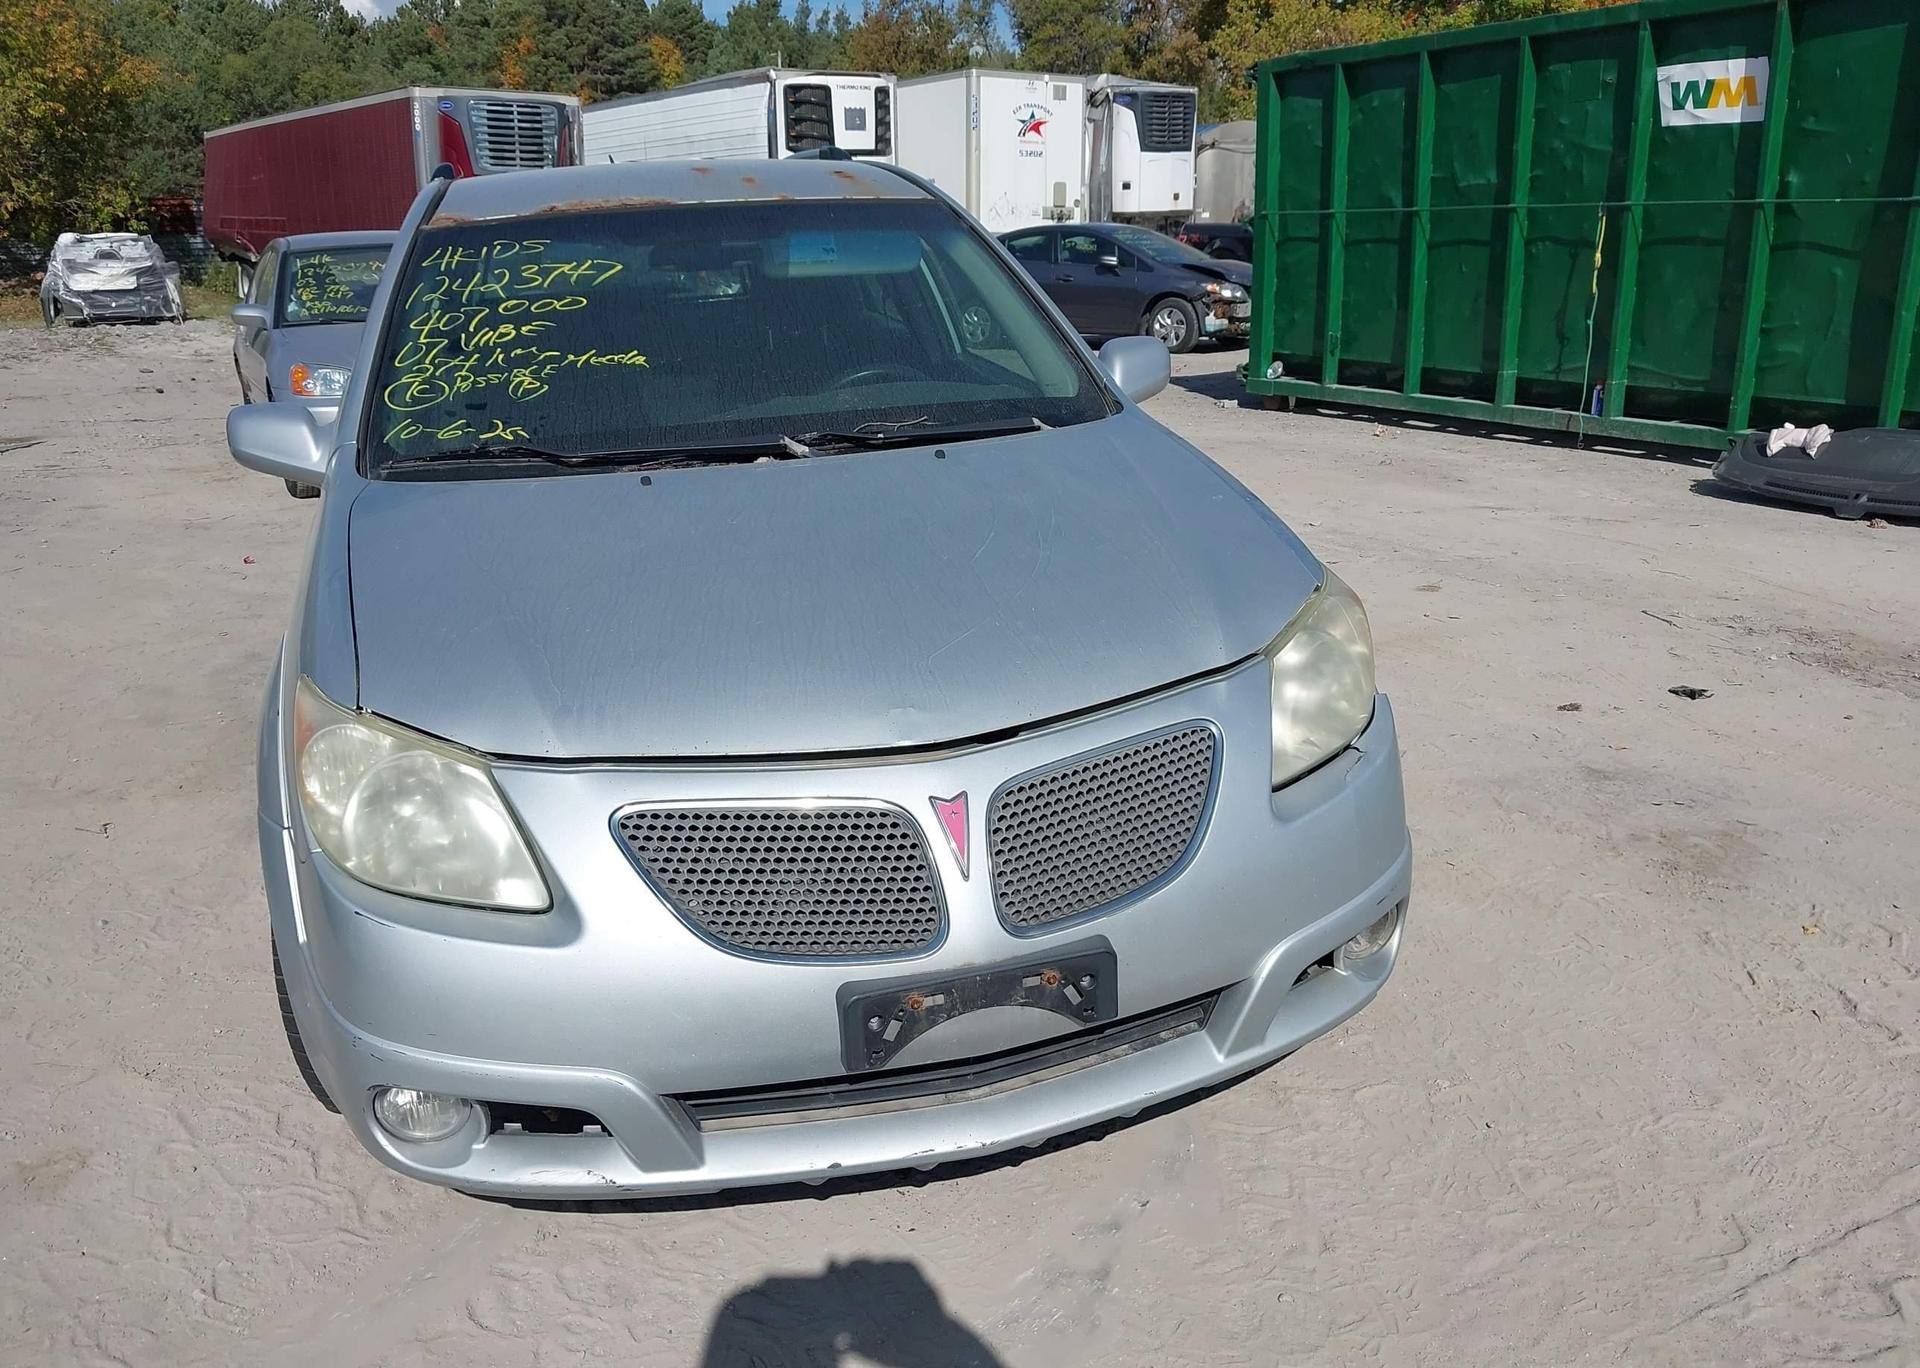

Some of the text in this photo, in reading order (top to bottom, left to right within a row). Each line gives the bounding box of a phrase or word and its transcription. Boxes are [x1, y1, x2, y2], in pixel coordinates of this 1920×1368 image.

[1670, 75, 1760, 111] WM
[1018, 149, 1043, 158] 53202
[405, 259, 624, 310] 12423747
[460, 320, 558, 351] VIBE
